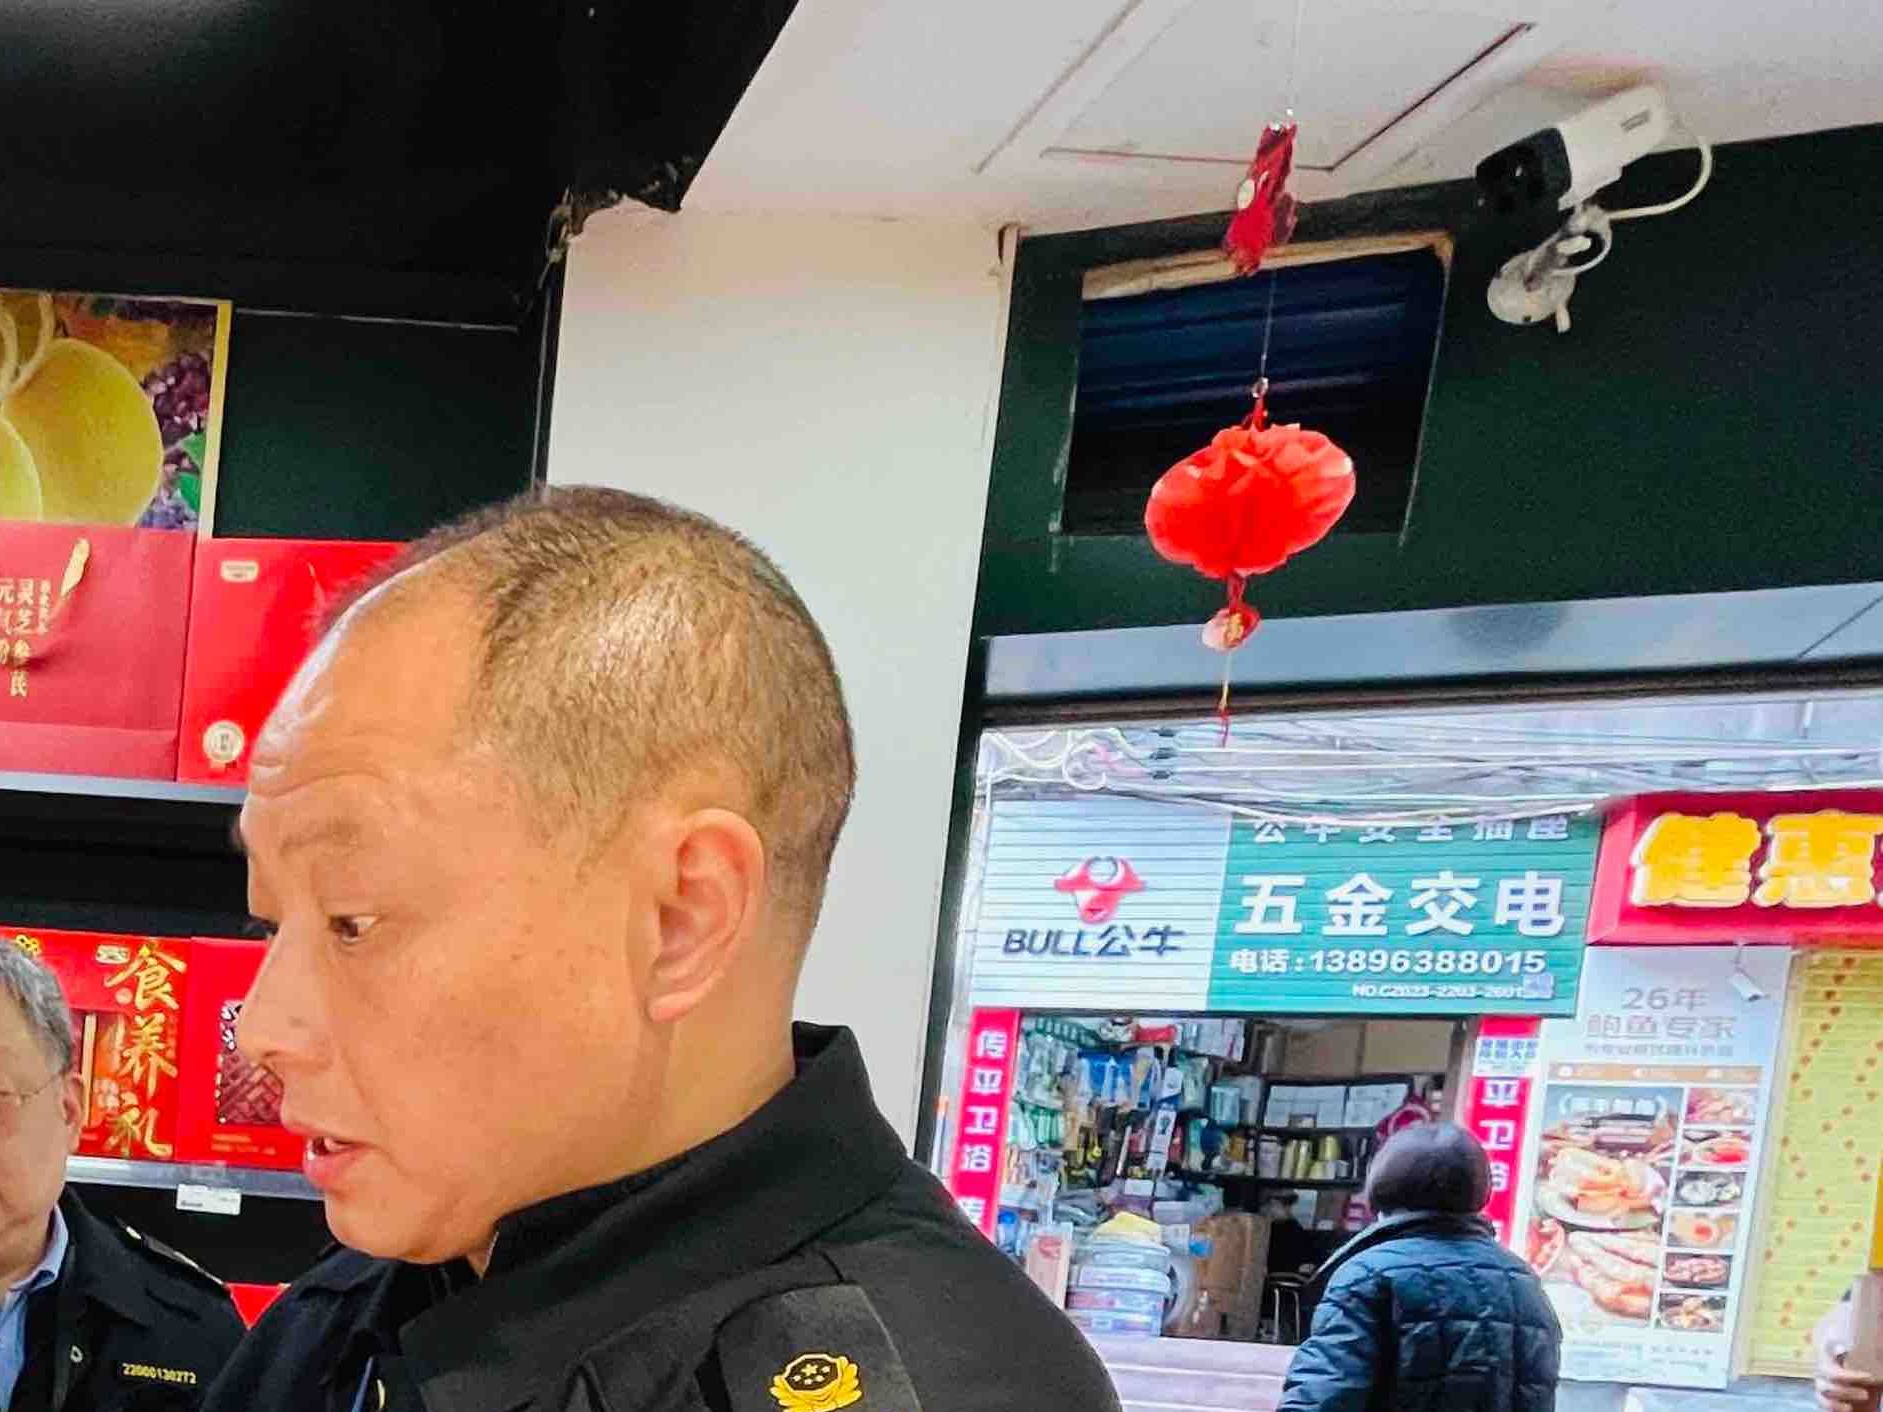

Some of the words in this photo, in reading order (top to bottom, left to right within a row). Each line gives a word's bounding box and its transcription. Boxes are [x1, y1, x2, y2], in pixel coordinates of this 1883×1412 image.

[1234, 870, 1565, 937] 五金交电
[1622, 986, 1711, 1011] 26年
